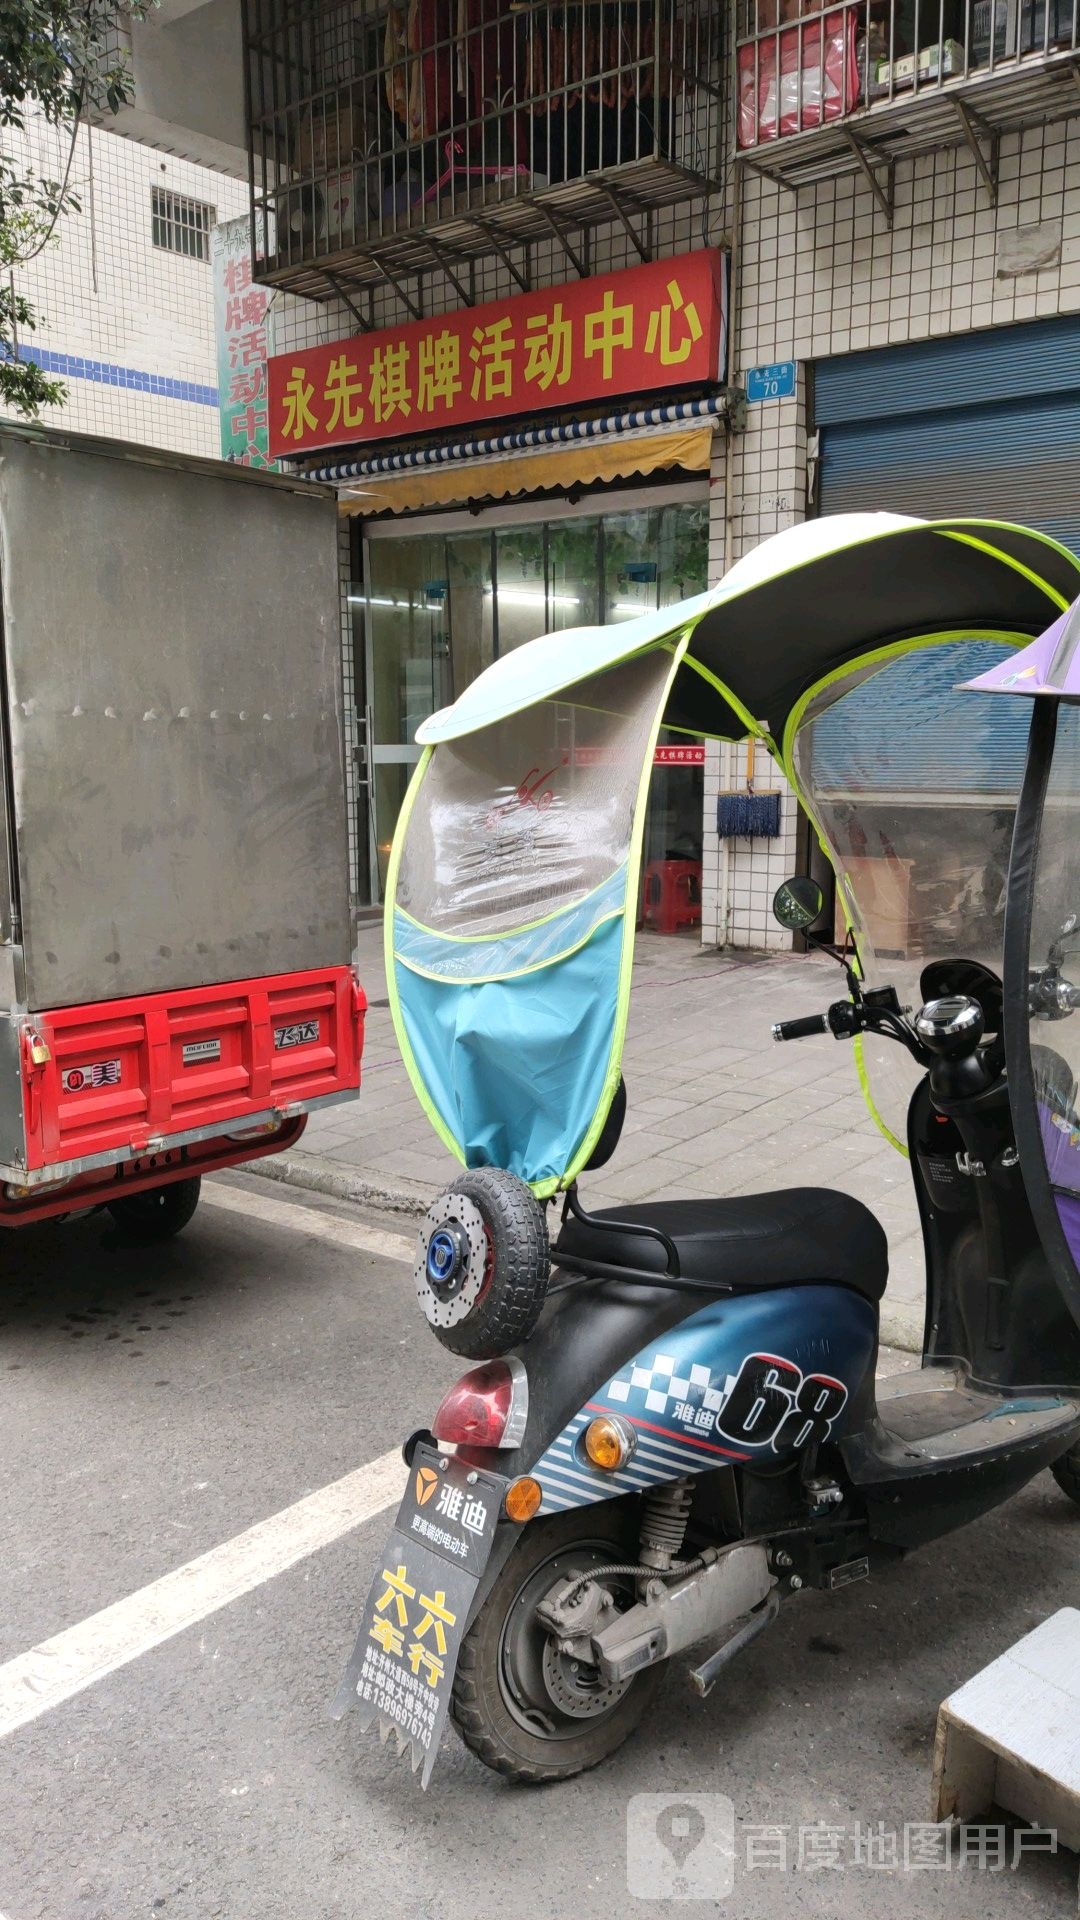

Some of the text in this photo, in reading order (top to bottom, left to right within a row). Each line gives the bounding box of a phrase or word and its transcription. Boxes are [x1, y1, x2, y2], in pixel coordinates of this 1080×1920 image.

[281, 280, 703, 440] 永先棋牌活动中心
[763, 381, 778, 397] 70
[277, 1022, 319, 1048] 飞达
[92, 1061, 117, 1087] 美
[671, 1401, 715, 1430] 雅迪
[716, 1352, 848, 1454] 68
[436, 1483, 487, 1537] 雅迪
[411, 1514, 469, 1559] 更高端的电动车
[375, 1565, 457, 1656] 六六
[369, 1614, 445, 1689] 车行
